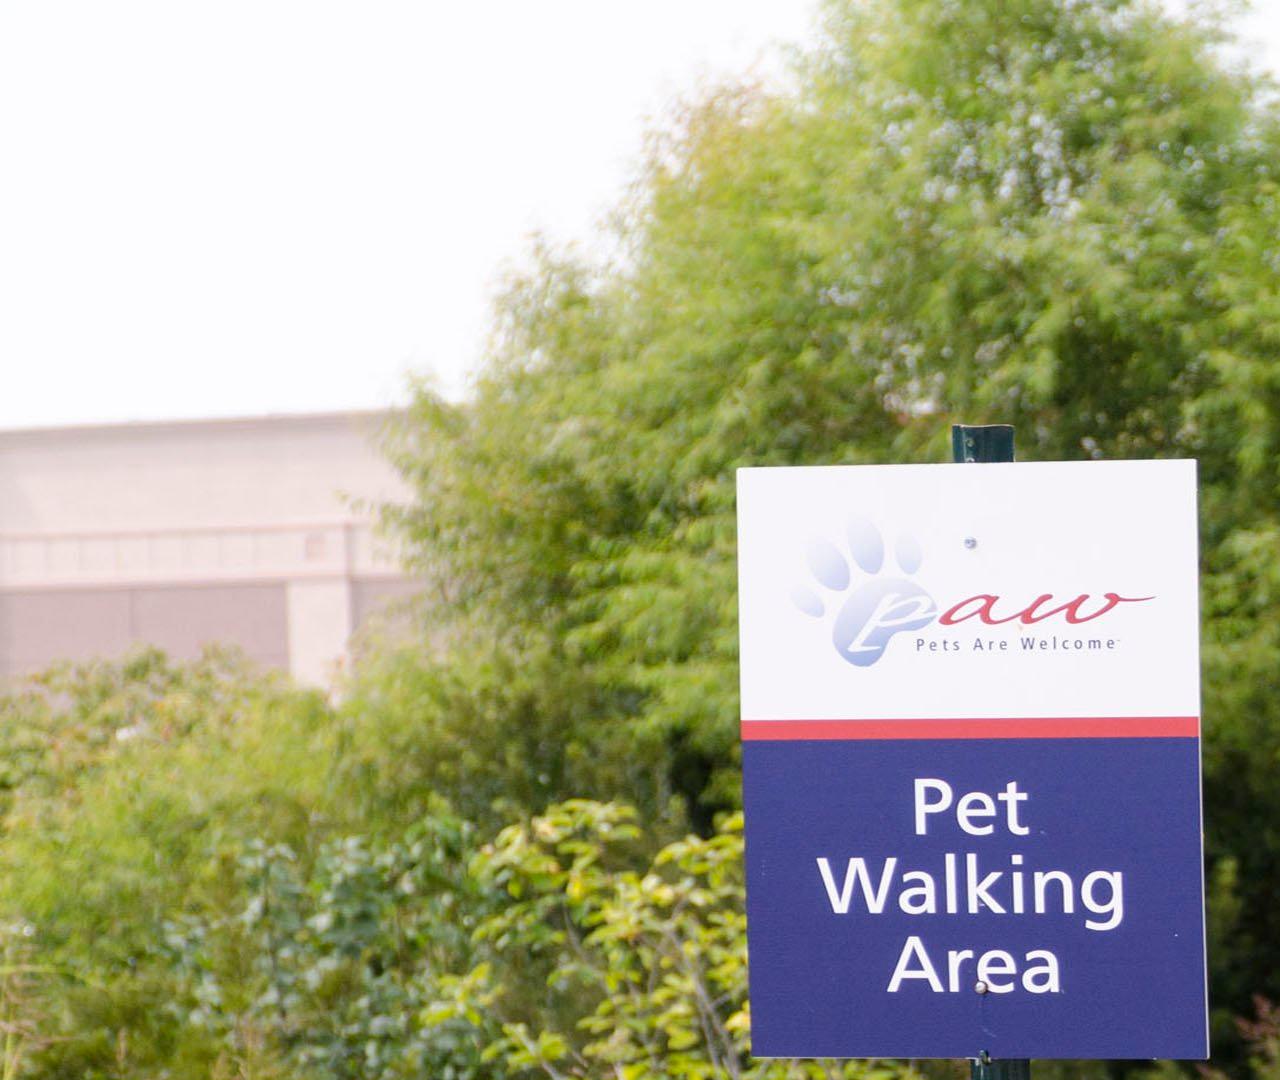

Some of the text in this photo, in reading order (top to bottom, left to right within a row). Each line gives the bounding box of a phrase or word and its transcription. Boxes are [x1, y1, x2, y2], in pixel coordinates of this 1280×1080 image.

[916, 638, 961, 652] Pets
[973, 637, 1008, 651] Are
[913, 778, 1029, 836] Pet
[817, 854, 1124, 931] Walking
[887, 936, 1061, 993] Area
